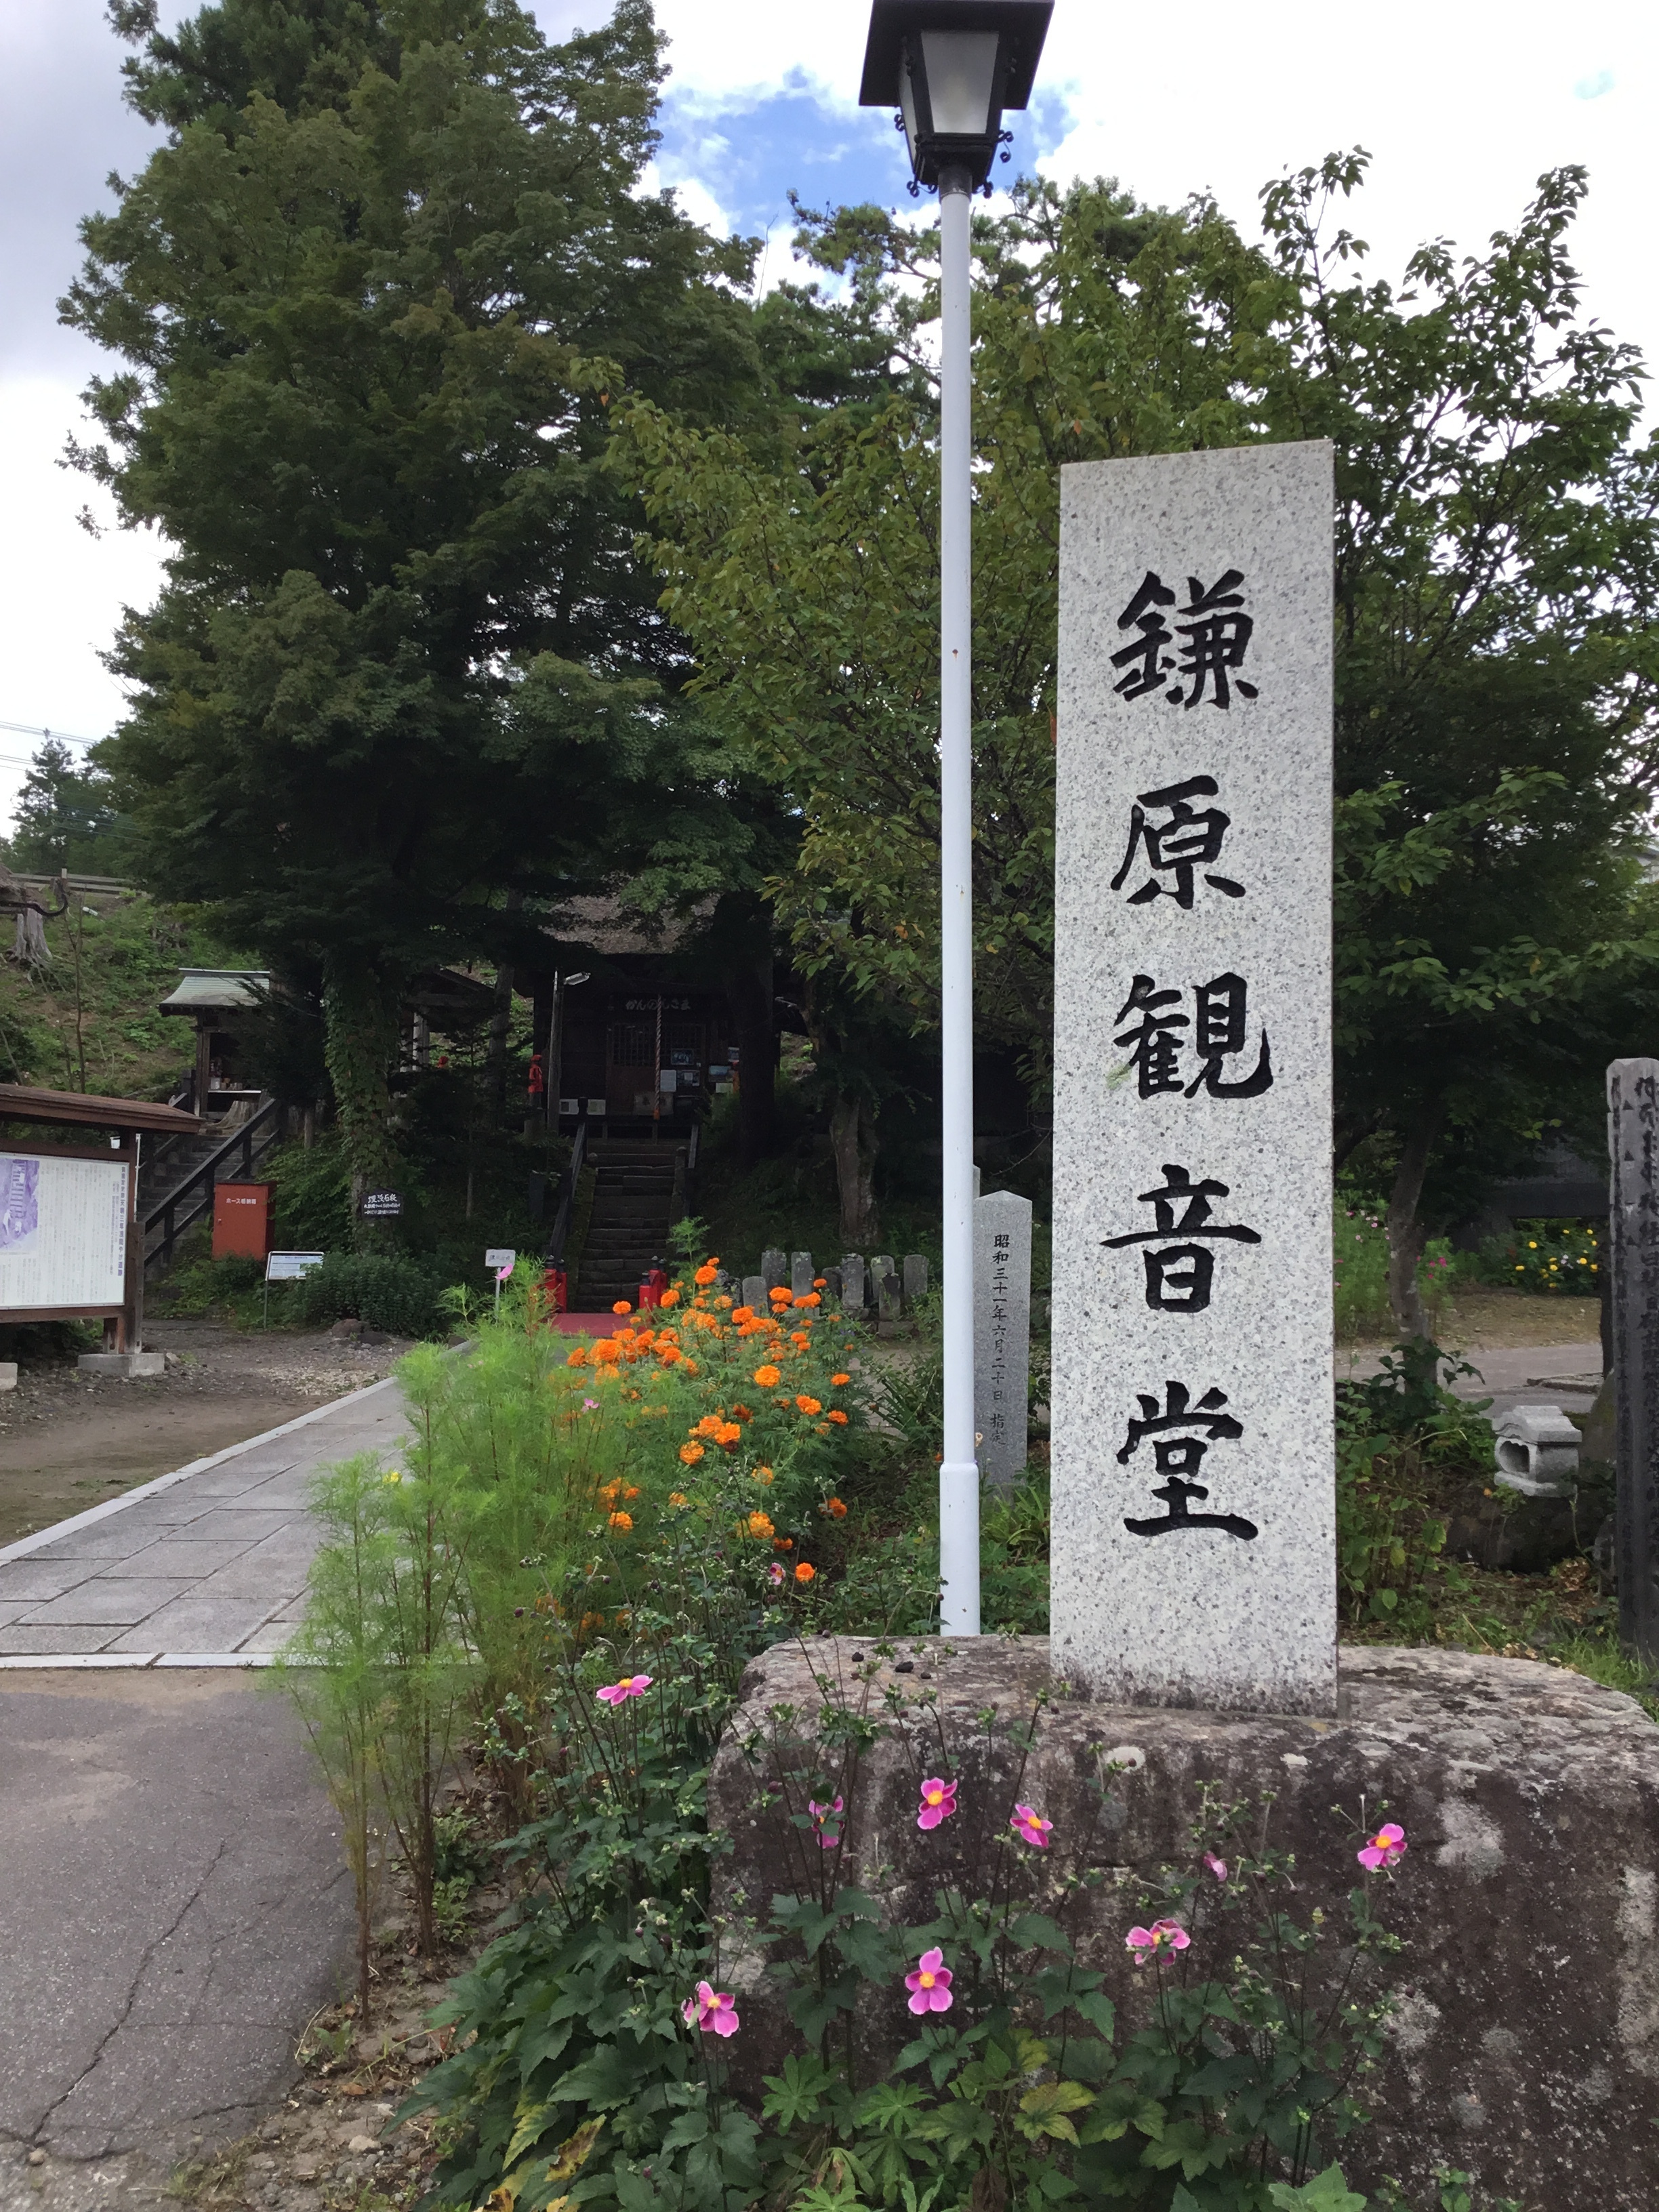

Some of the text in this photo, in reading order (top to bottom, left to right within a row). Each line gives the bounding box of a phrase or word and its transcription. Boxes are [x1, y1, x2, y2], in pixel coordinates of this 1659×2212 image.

[991, 1233, 1010, 1401] 昭和三十一年六月二十日
[1100, 570, 1273, 1540] 鎌原観音堂
